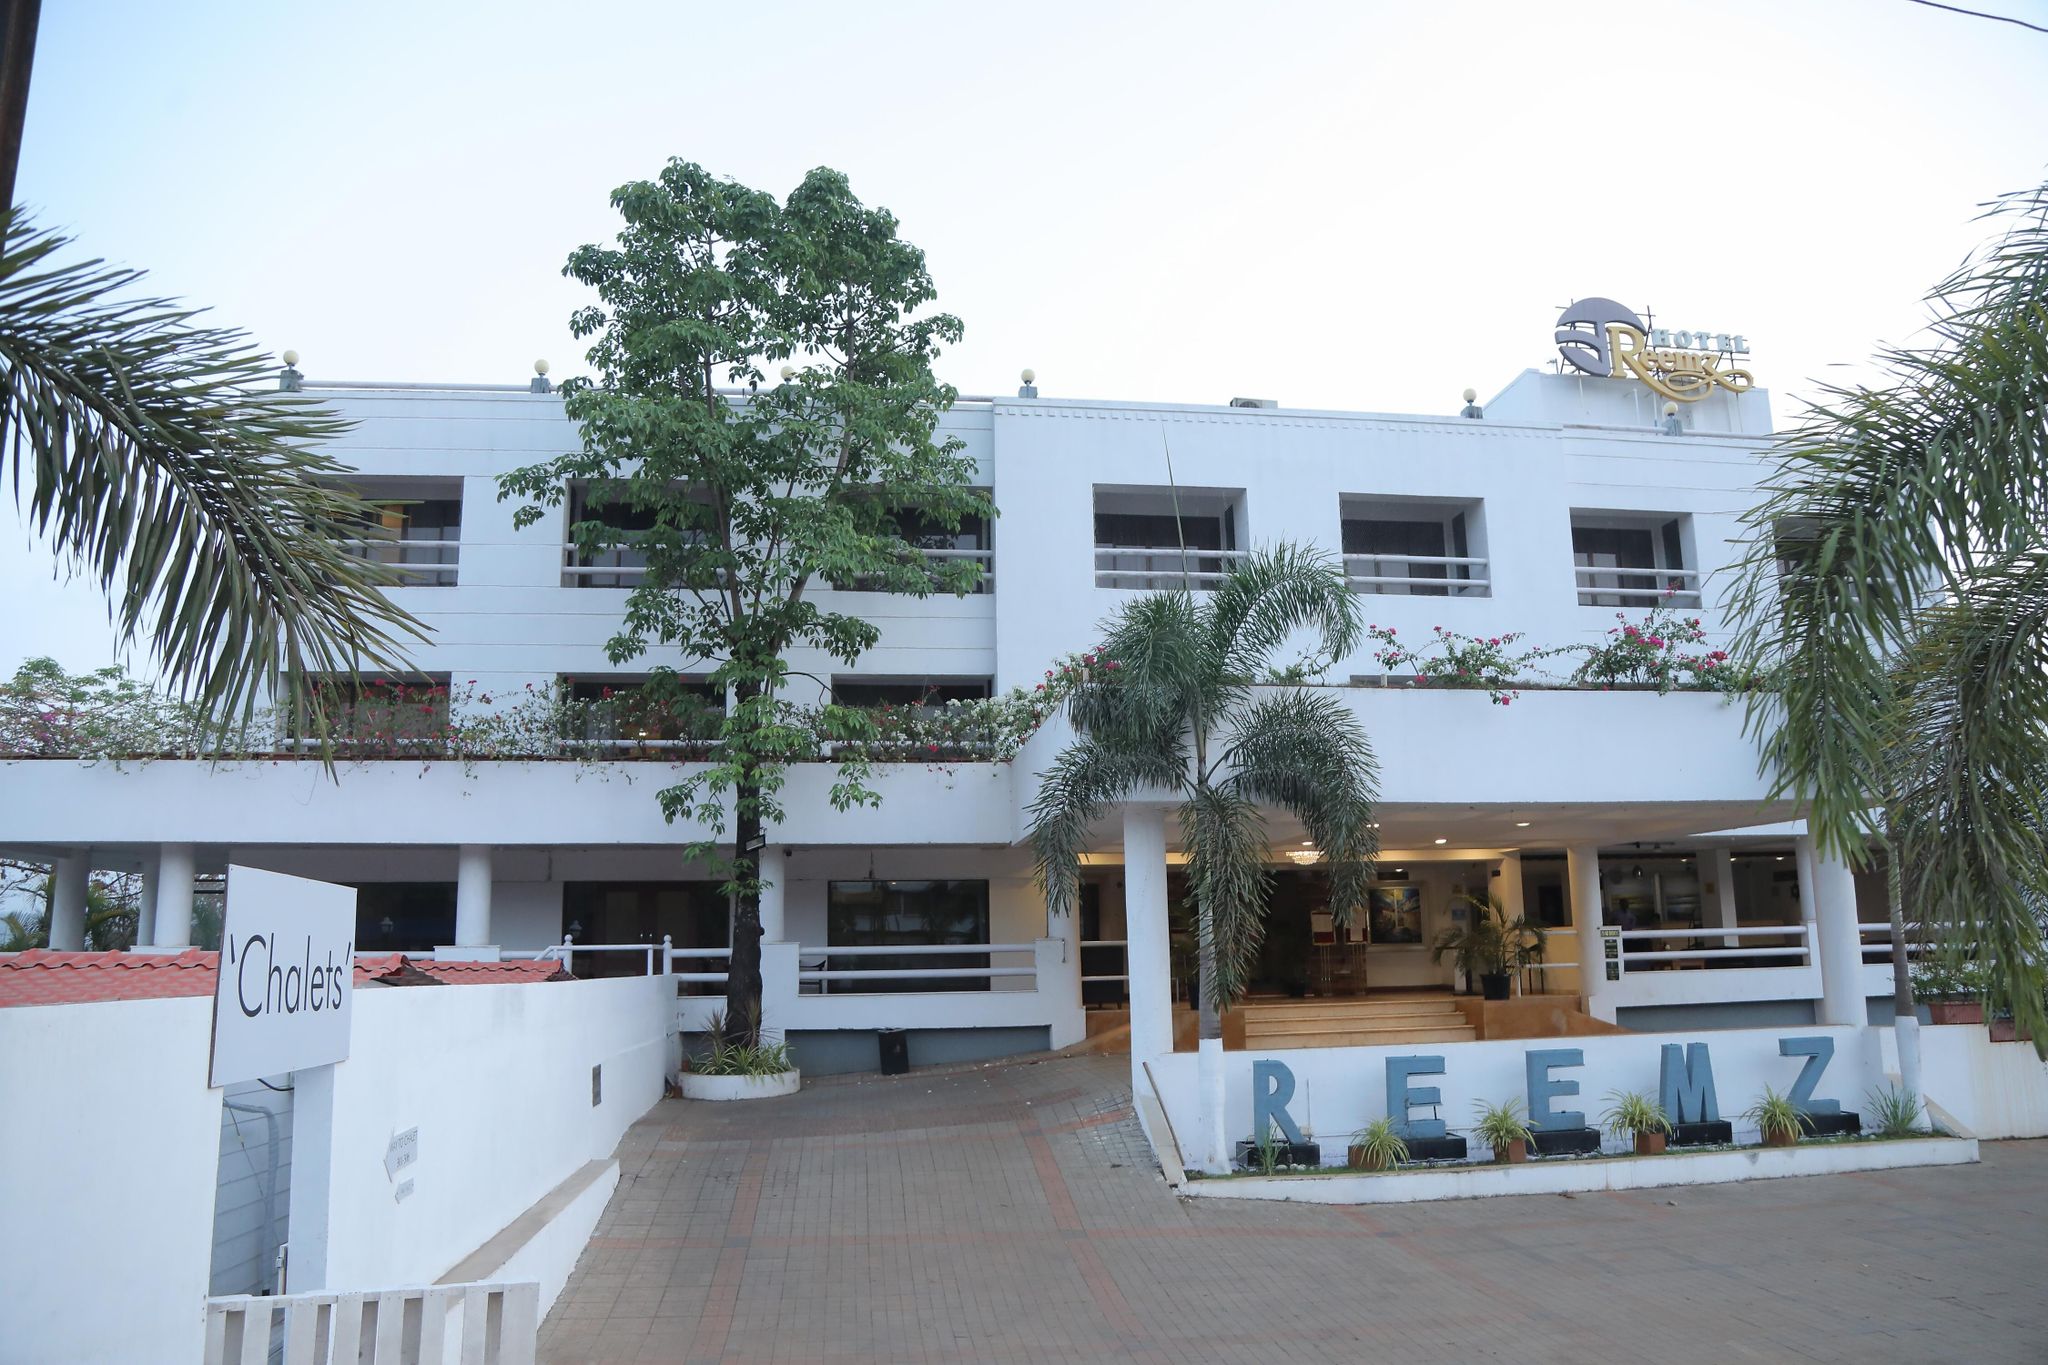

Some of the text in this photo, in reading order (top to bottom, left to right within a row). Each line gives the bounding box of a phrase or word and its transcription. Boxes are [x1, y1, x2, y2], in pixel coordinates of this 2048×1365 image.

[1607, 325, 1754, 403] Reemz
[1651, 328, 1750, 354] HOTEL
[1252, 1036, 1840, 1145] REEMZ
